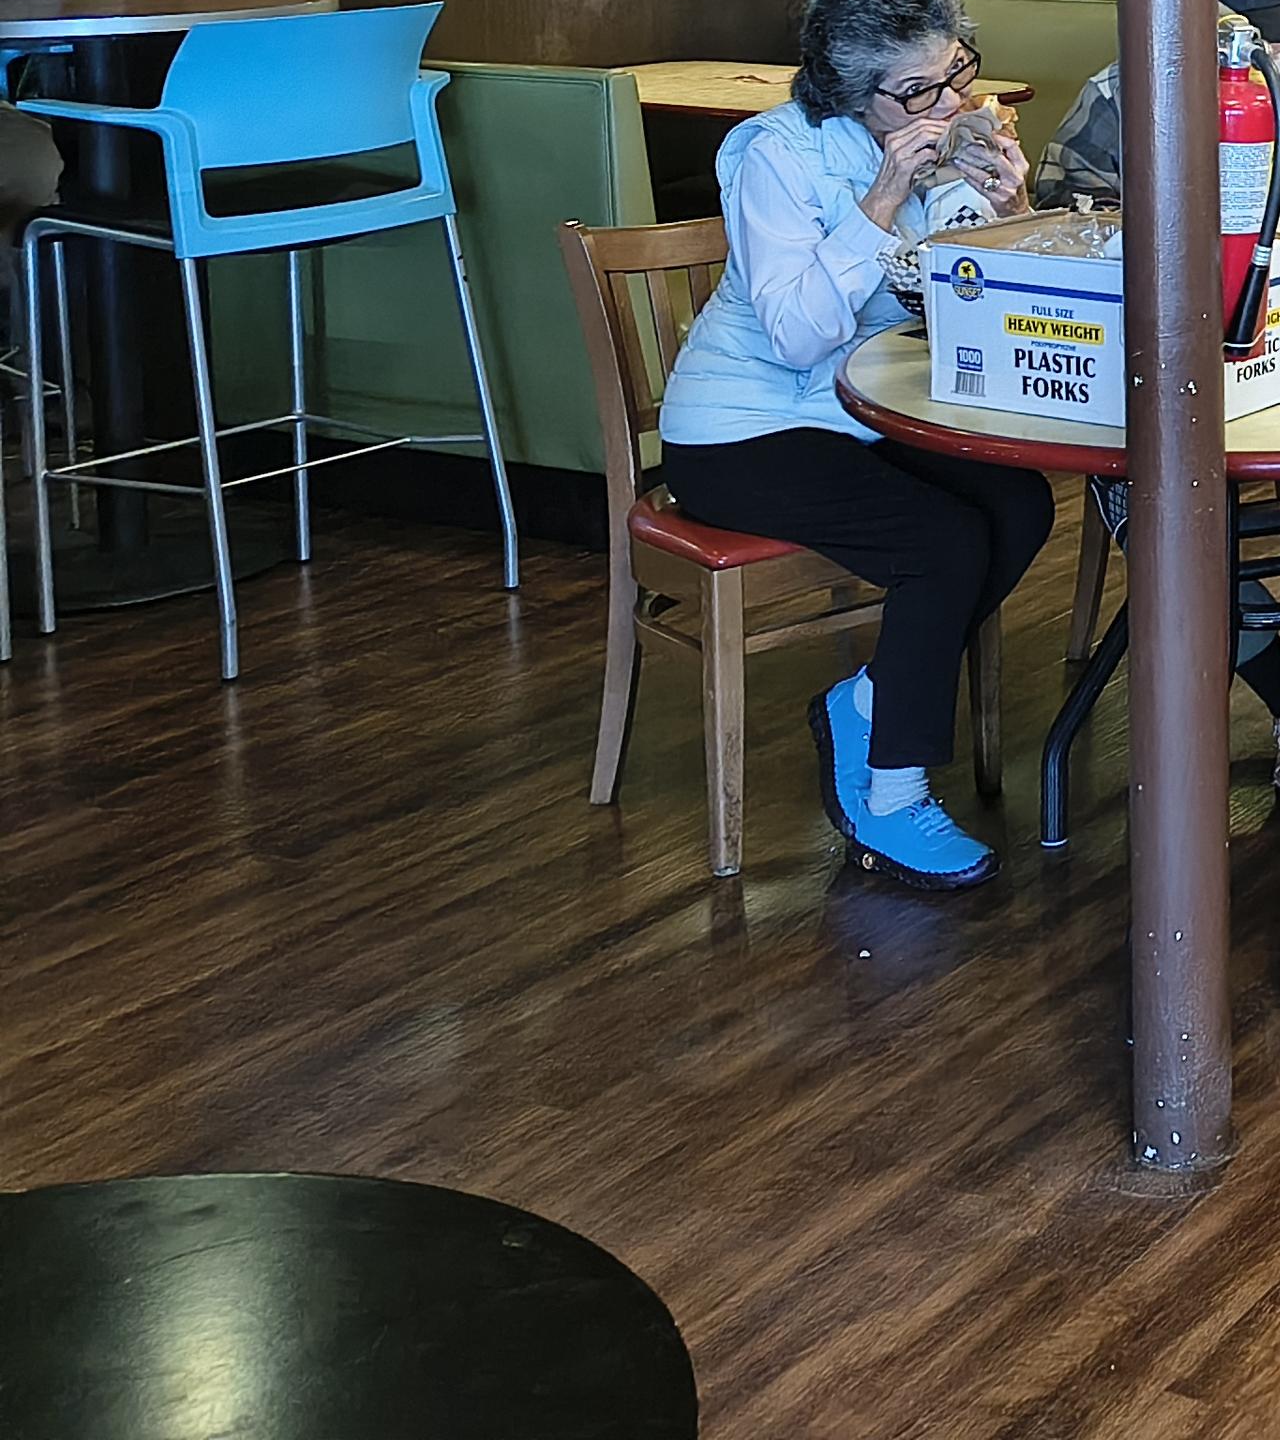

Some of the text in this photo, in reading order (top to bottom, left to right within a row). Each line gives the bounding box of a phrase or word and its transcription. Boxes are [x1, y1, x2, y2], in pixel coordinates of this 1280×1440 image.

[954, 285, 983, 298] SUNSET
[1031, 305, 1075, 320] FULL SIZE
[1008, 317, 1101, 342] HEAVY WEIGHT
[958, 349, 982, 366] 1000
[1014, 347, 1097, 379] PLASTIC
[1236, 357, 1277, 384] FORKS
[1022, 375, 1090, 405] FORKS
